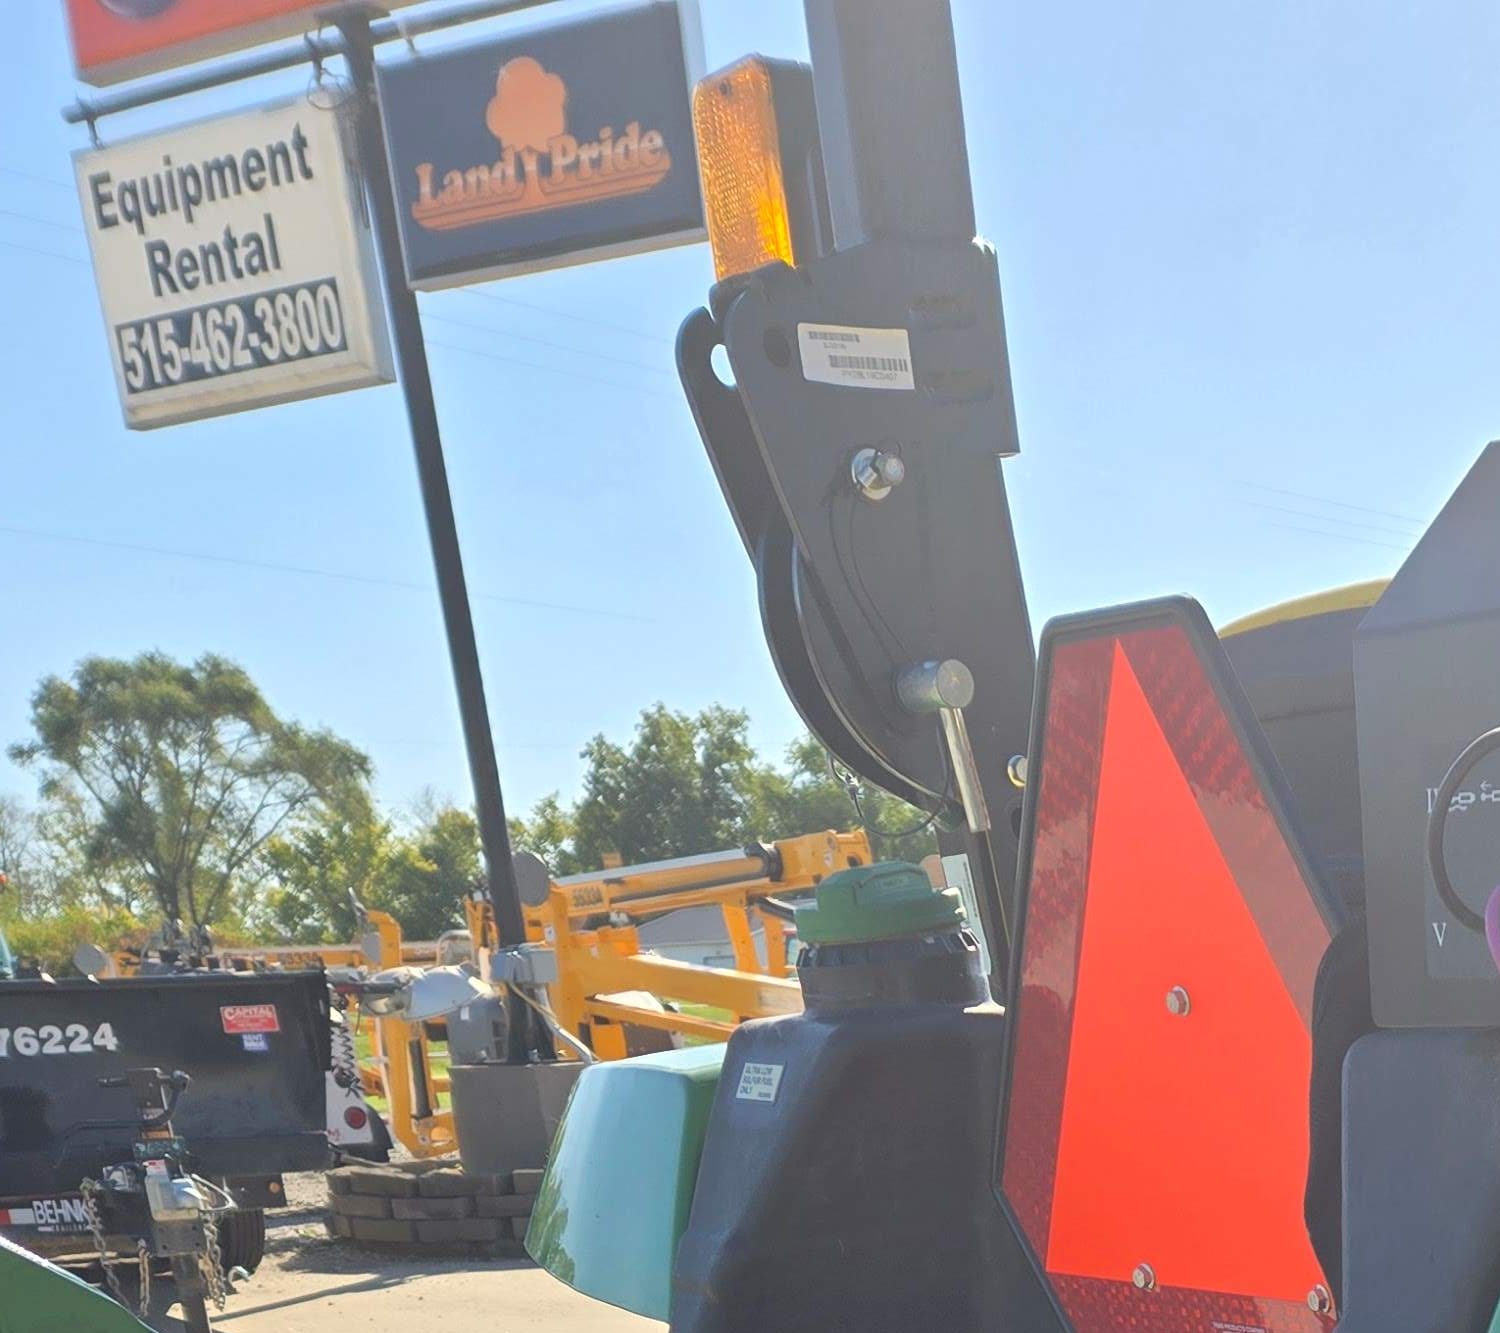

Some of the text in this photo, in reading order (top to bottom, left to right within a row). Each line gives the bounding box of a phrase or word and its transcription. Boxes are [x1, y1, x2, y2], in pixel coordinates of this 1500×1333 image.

[88, 120, 314, 235] Equipment
[413, 121, 664, 208] Land Pride
[145, 213, 282, 297] Rental
[119, 283, 342, 390] 515-462-3800
[1432, 922, 1447, 948] V
[32, 1198, 92, 1224] BEHNK
